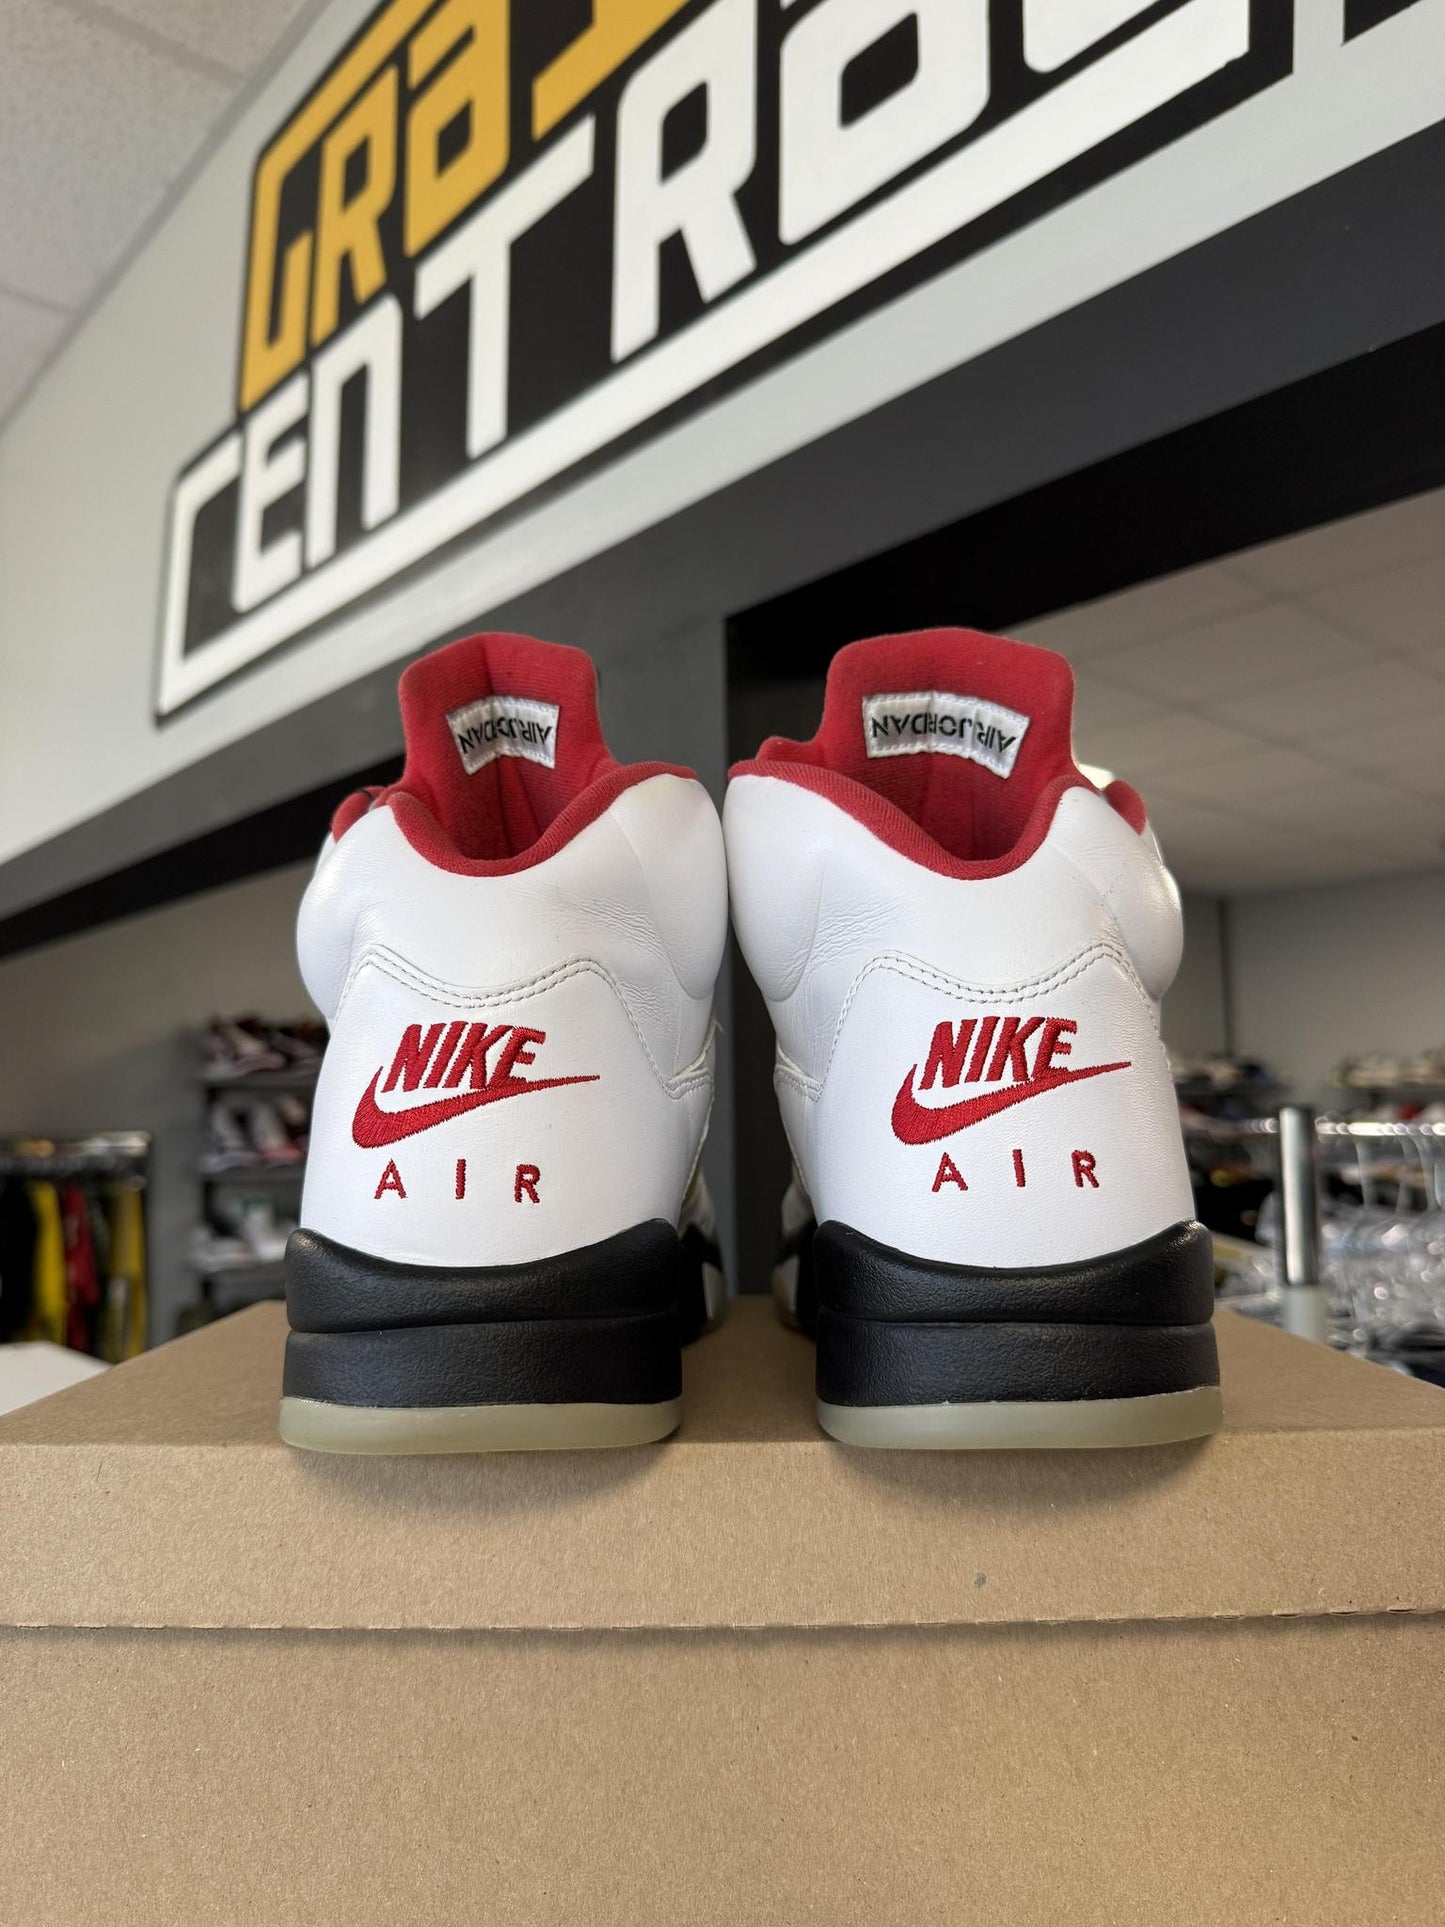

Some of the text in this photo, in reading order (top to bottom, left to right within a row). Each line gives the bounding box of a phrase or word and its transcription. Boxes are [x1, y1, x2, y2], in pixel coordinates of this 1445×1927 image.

[381, 1020, 546, 1093] NIKE
[918, 1016, 1078, 1090] NIKE
[374, 1158, 541, 1204] AIR
[931, 1149, 1100, 1193] AIR
